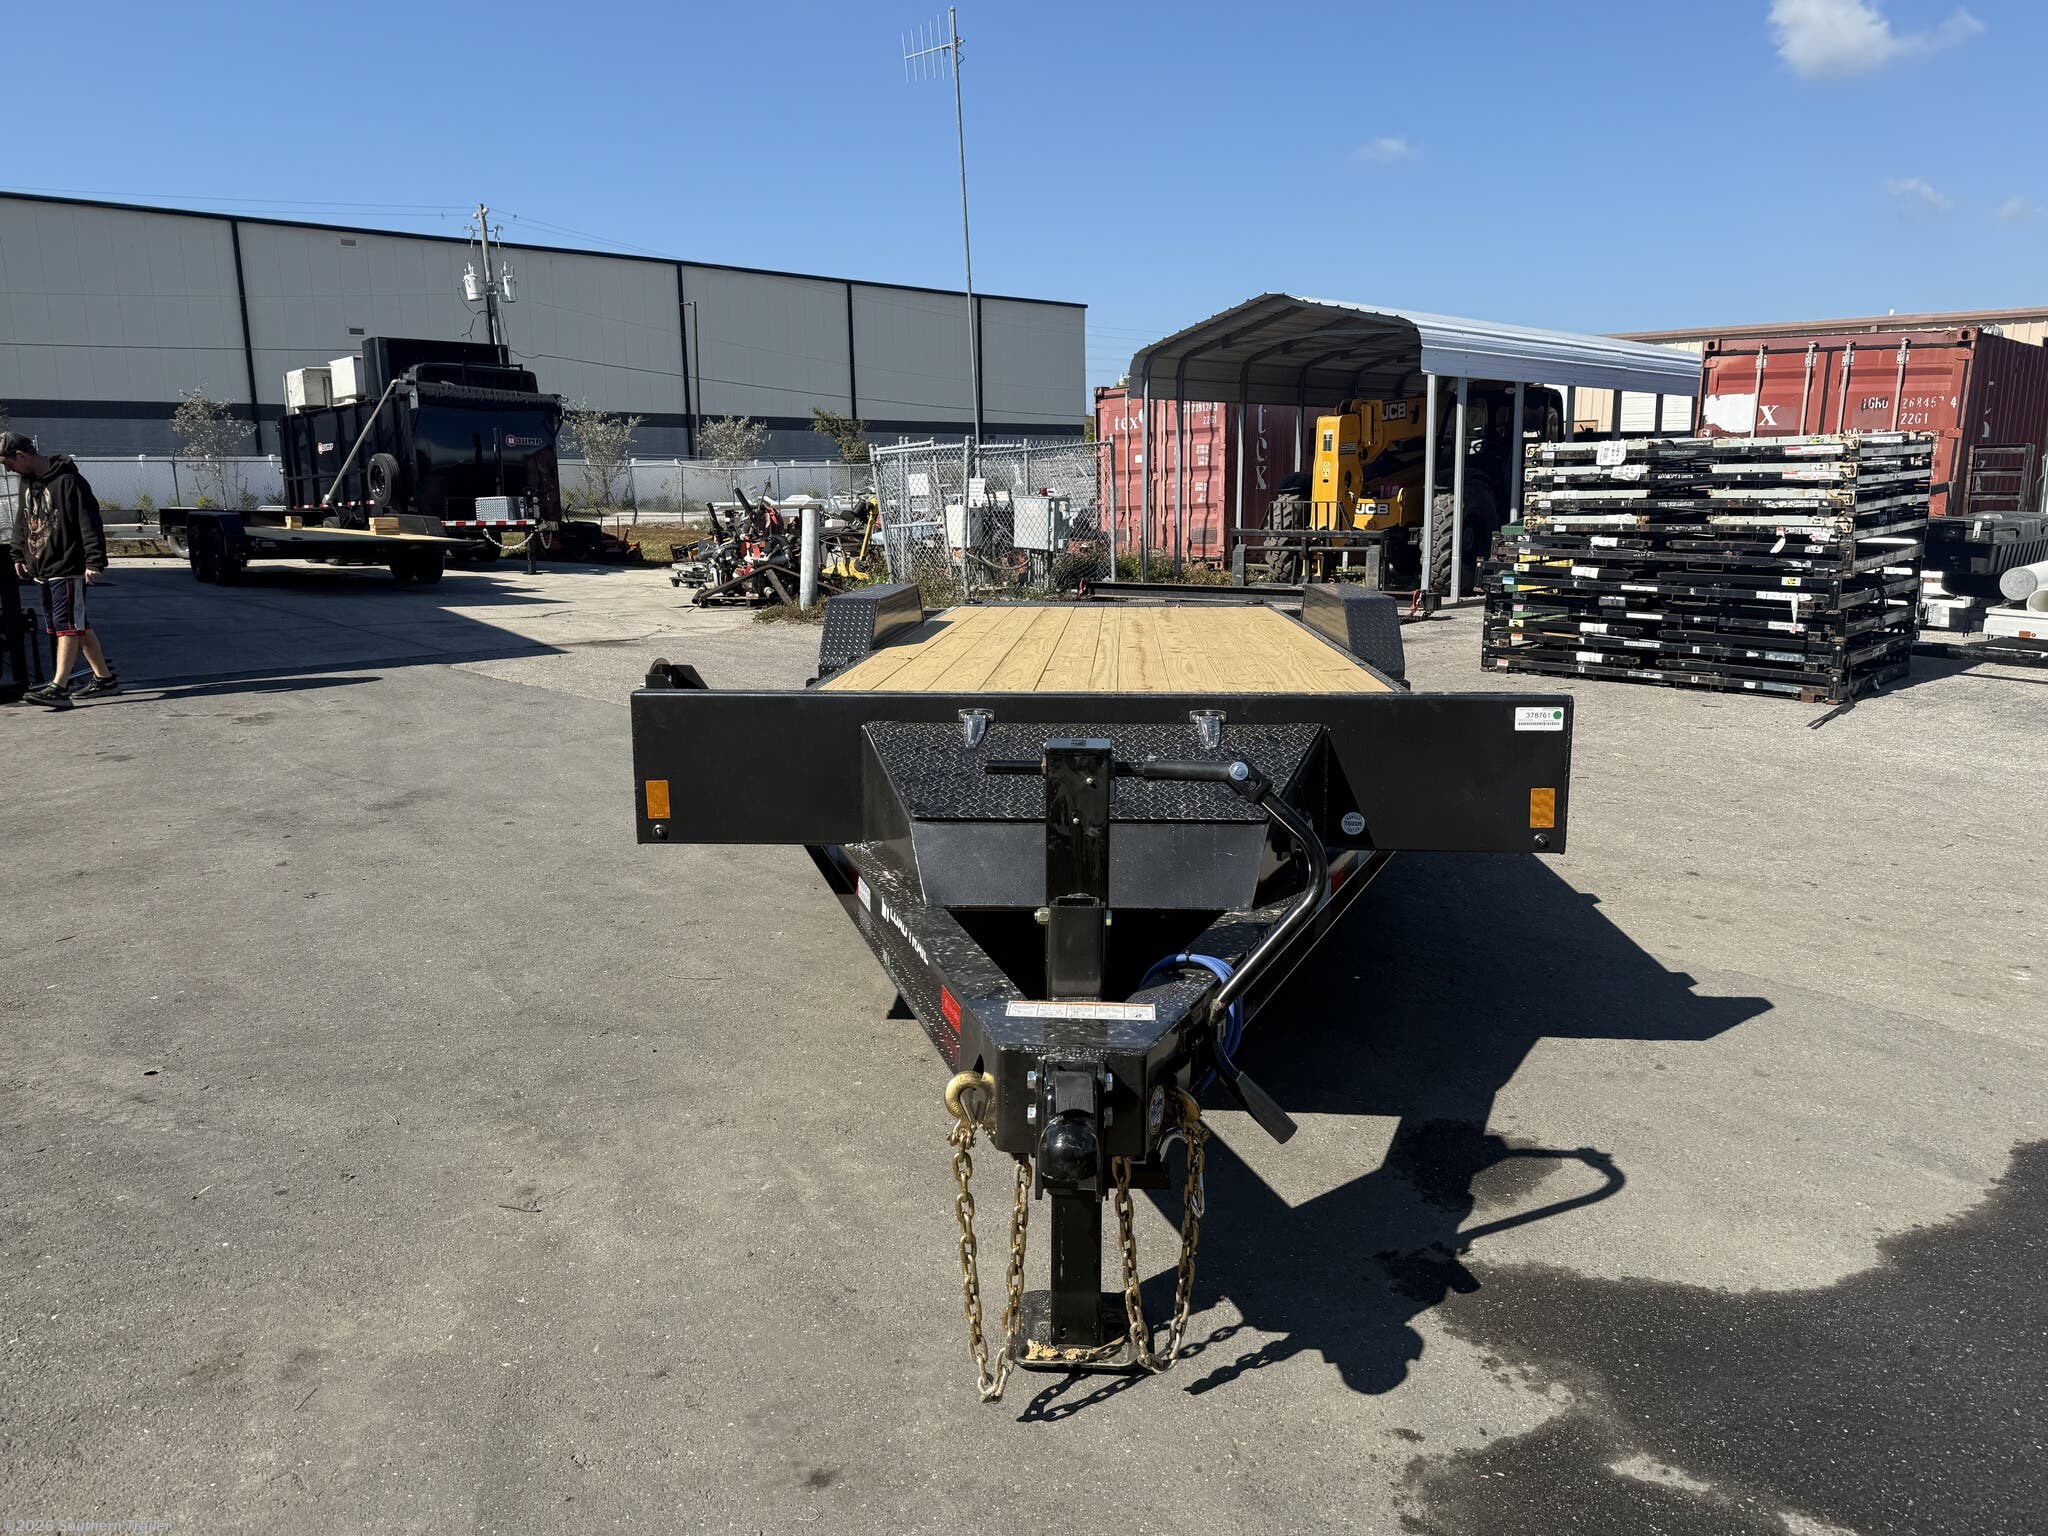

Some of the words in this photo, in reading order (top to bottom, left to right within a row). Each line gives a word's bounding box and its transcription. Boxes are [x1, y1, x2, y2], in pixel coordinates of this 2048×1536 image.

[1950, 396, 1957, 408] 4
[1383, 403, 1406, 418] JCB
[1900, 413, 1928, 425] 22G1
[1355, 503, 1389, 514] JCB
